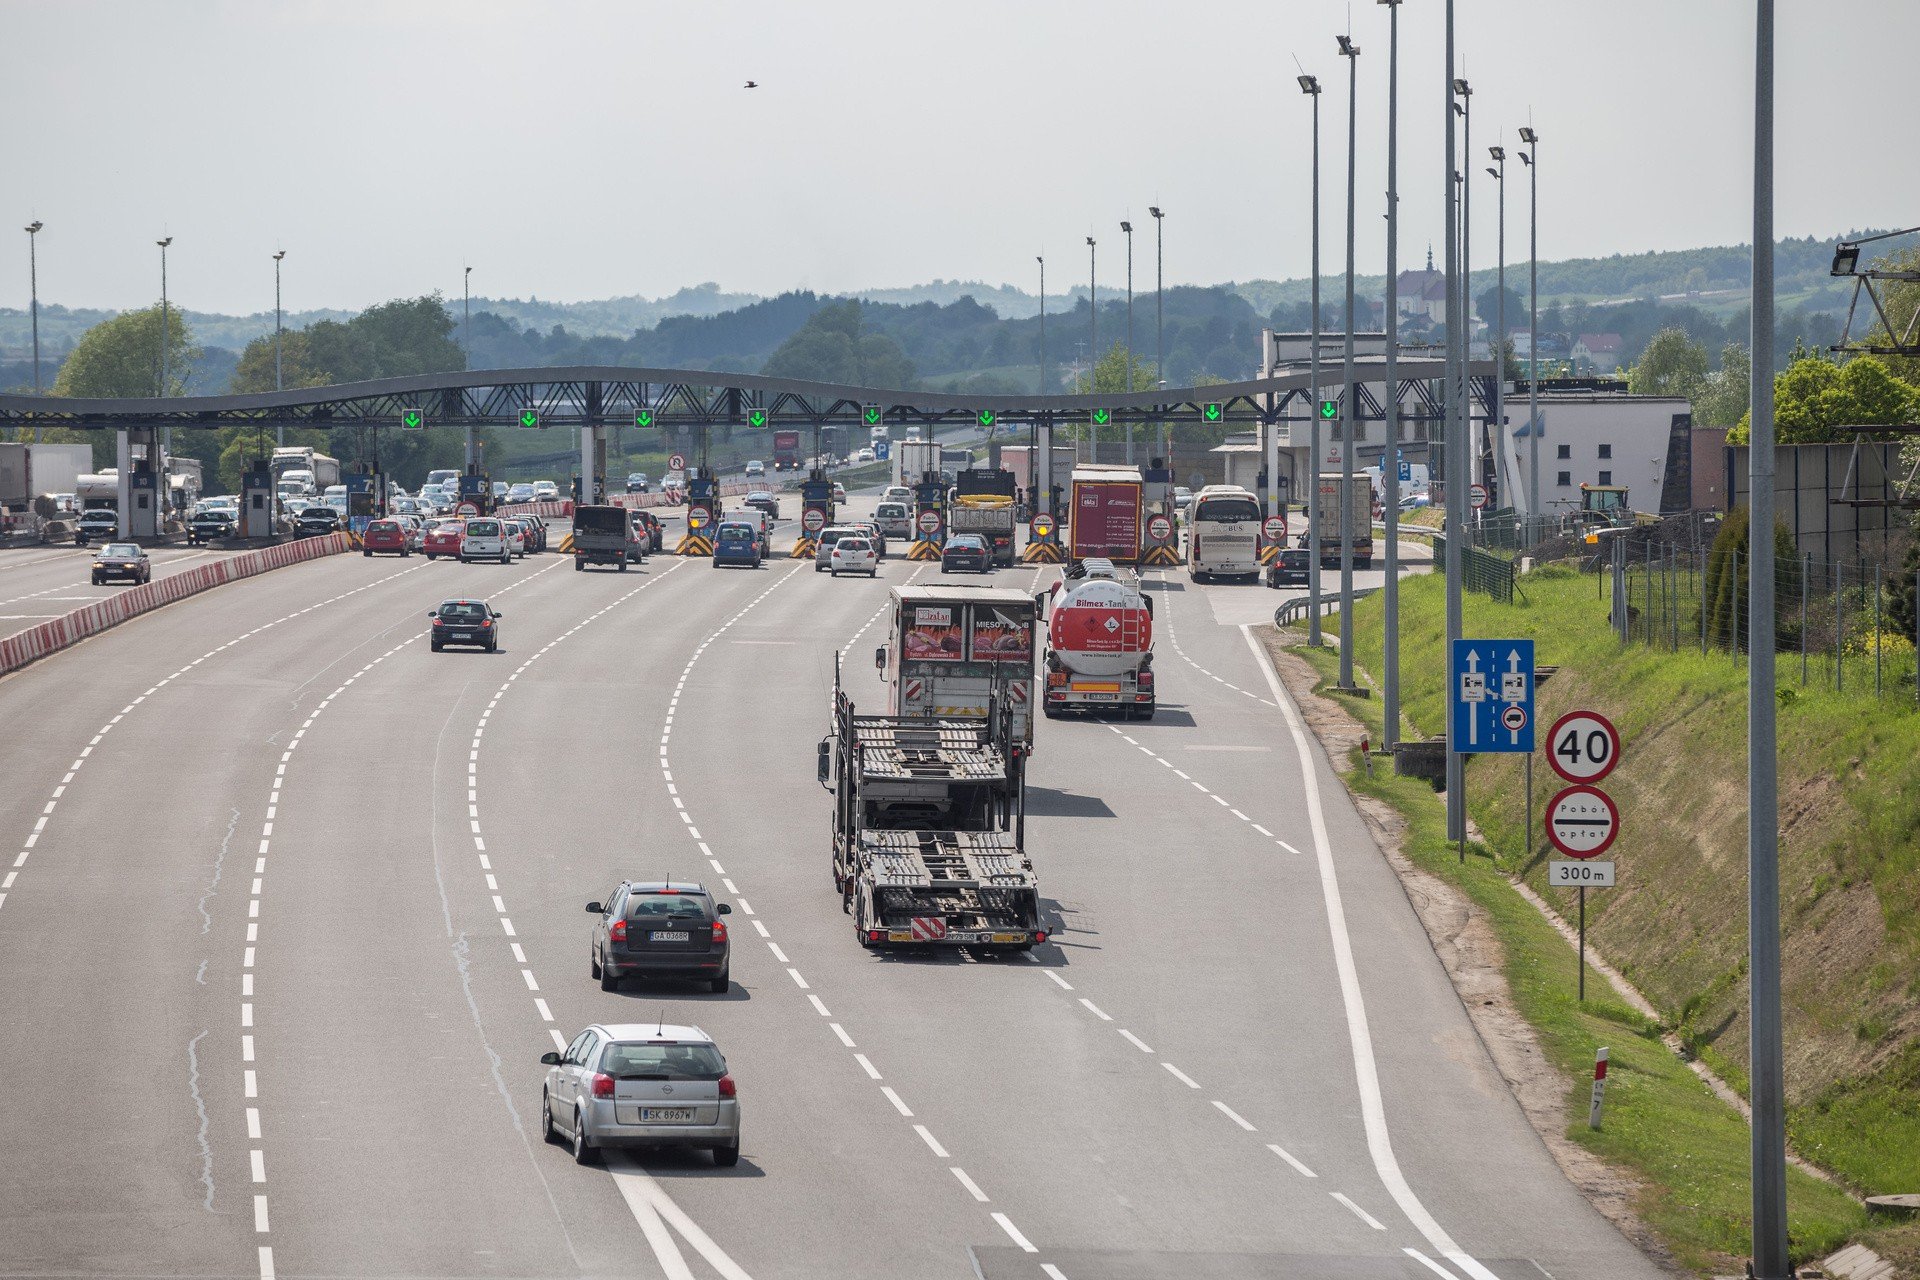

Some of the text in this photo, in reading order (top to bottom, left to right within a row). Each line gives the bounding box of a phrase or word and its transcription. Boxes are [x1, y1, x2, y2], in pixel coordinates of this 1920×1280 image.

[878, 443, 888, 456] P
[1401, 462, 1409, 473] P
[363, 479, 374, 492] 7
[477, 480, 486, 493] 6
[705, 484, 713, 497] 4
[932, 488, 941, 500] 2
[976, 621, 1000, 629] MIĘSO
[1557, 729, 1609, 764] 40
[1561, 804, 1606, 813] Pobór
[1560, 829, 1605, 839] opłat
[1560, 866, 1604, 880] 300 m
[654, 931, 665, 940] GA
[1594, 1100, 1600, 1110] 7
[649, 1110, 691, 1120] SK 8967W
